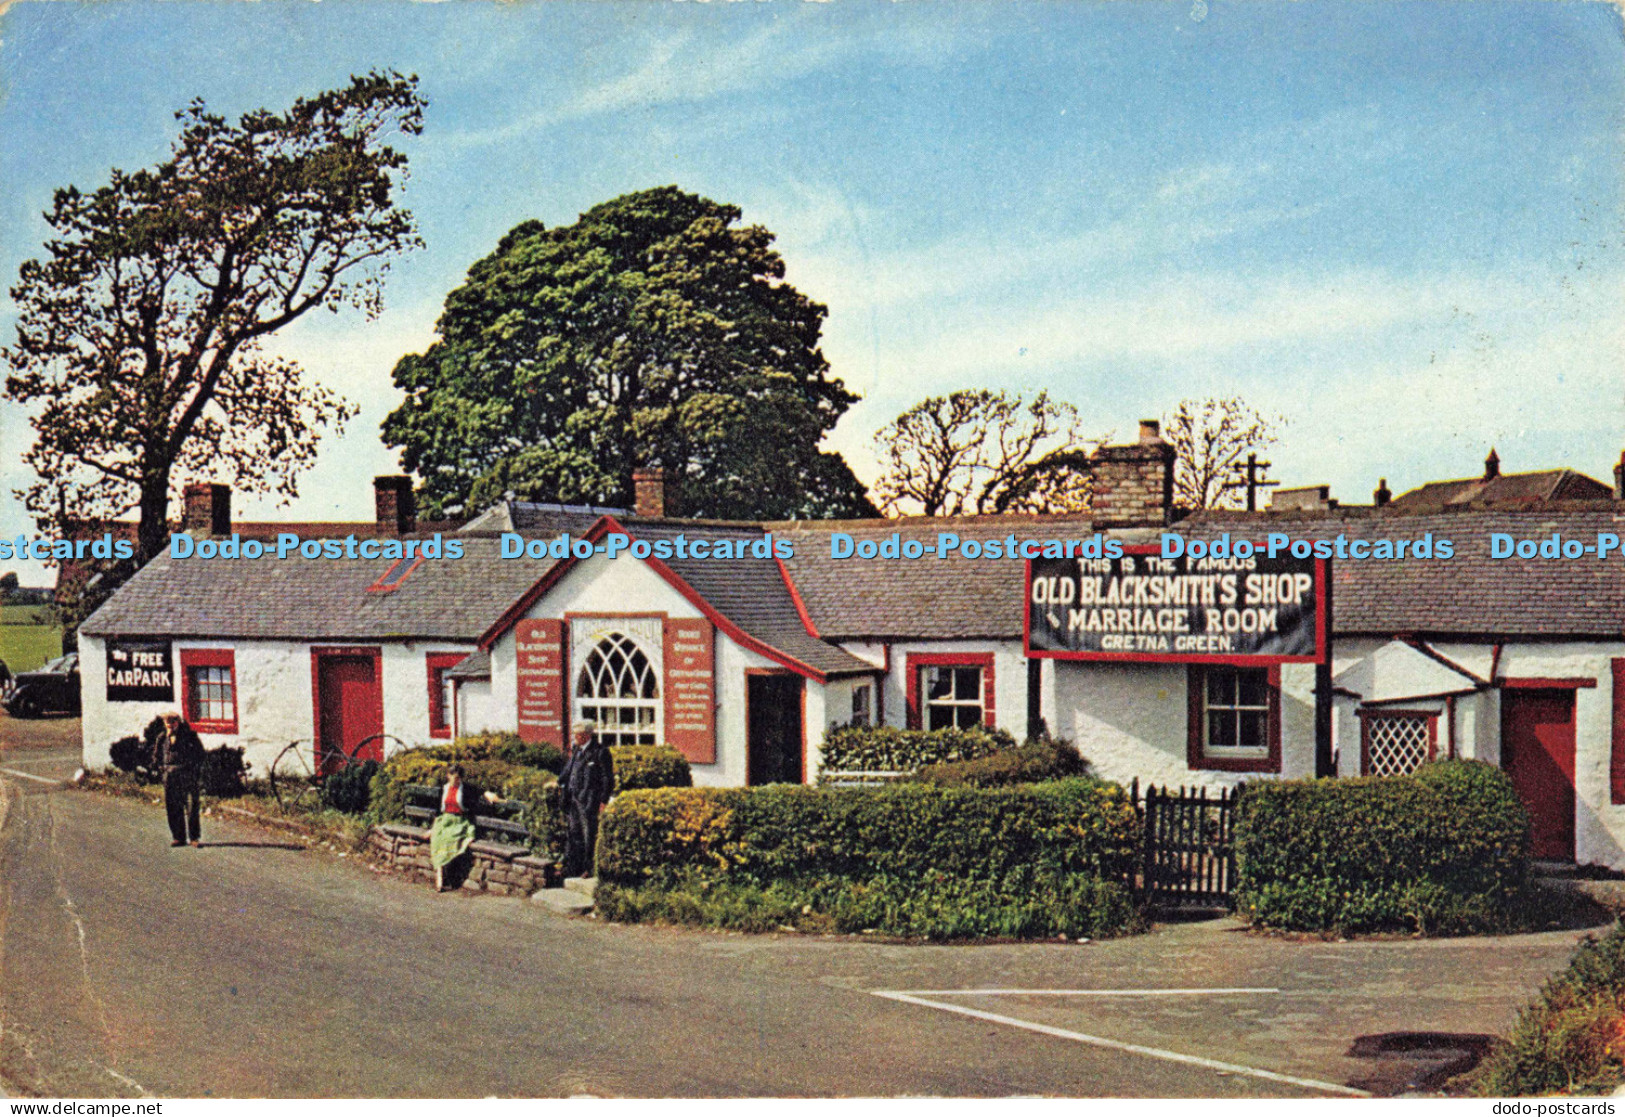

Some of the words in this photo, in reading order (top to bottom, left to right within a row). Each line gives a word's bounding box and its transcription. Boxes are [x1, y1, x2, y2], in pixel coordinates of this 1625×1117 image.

[1077, 557, 1111, 572] THIS
[1120, 557, 1135, 572] IS
[1145, 557, 1176, 571] THE
[1186, 556, 1257, 570] FAMOUS
[1032, 576, 1075, 604] OLD
[1080, 574, 1237, 604] BLACKSMITH'S
[1245, 573, 1312, 604] SHOP
[1068, 608, 1190, 632] MARRIAGE
[1206, 608, 1278, 632] ROOM
[1101, 634, 1169, 651] GRETNA
[1174, 634, 1236, 651] GREEN.
[132, 652, 164, 667] FREE
